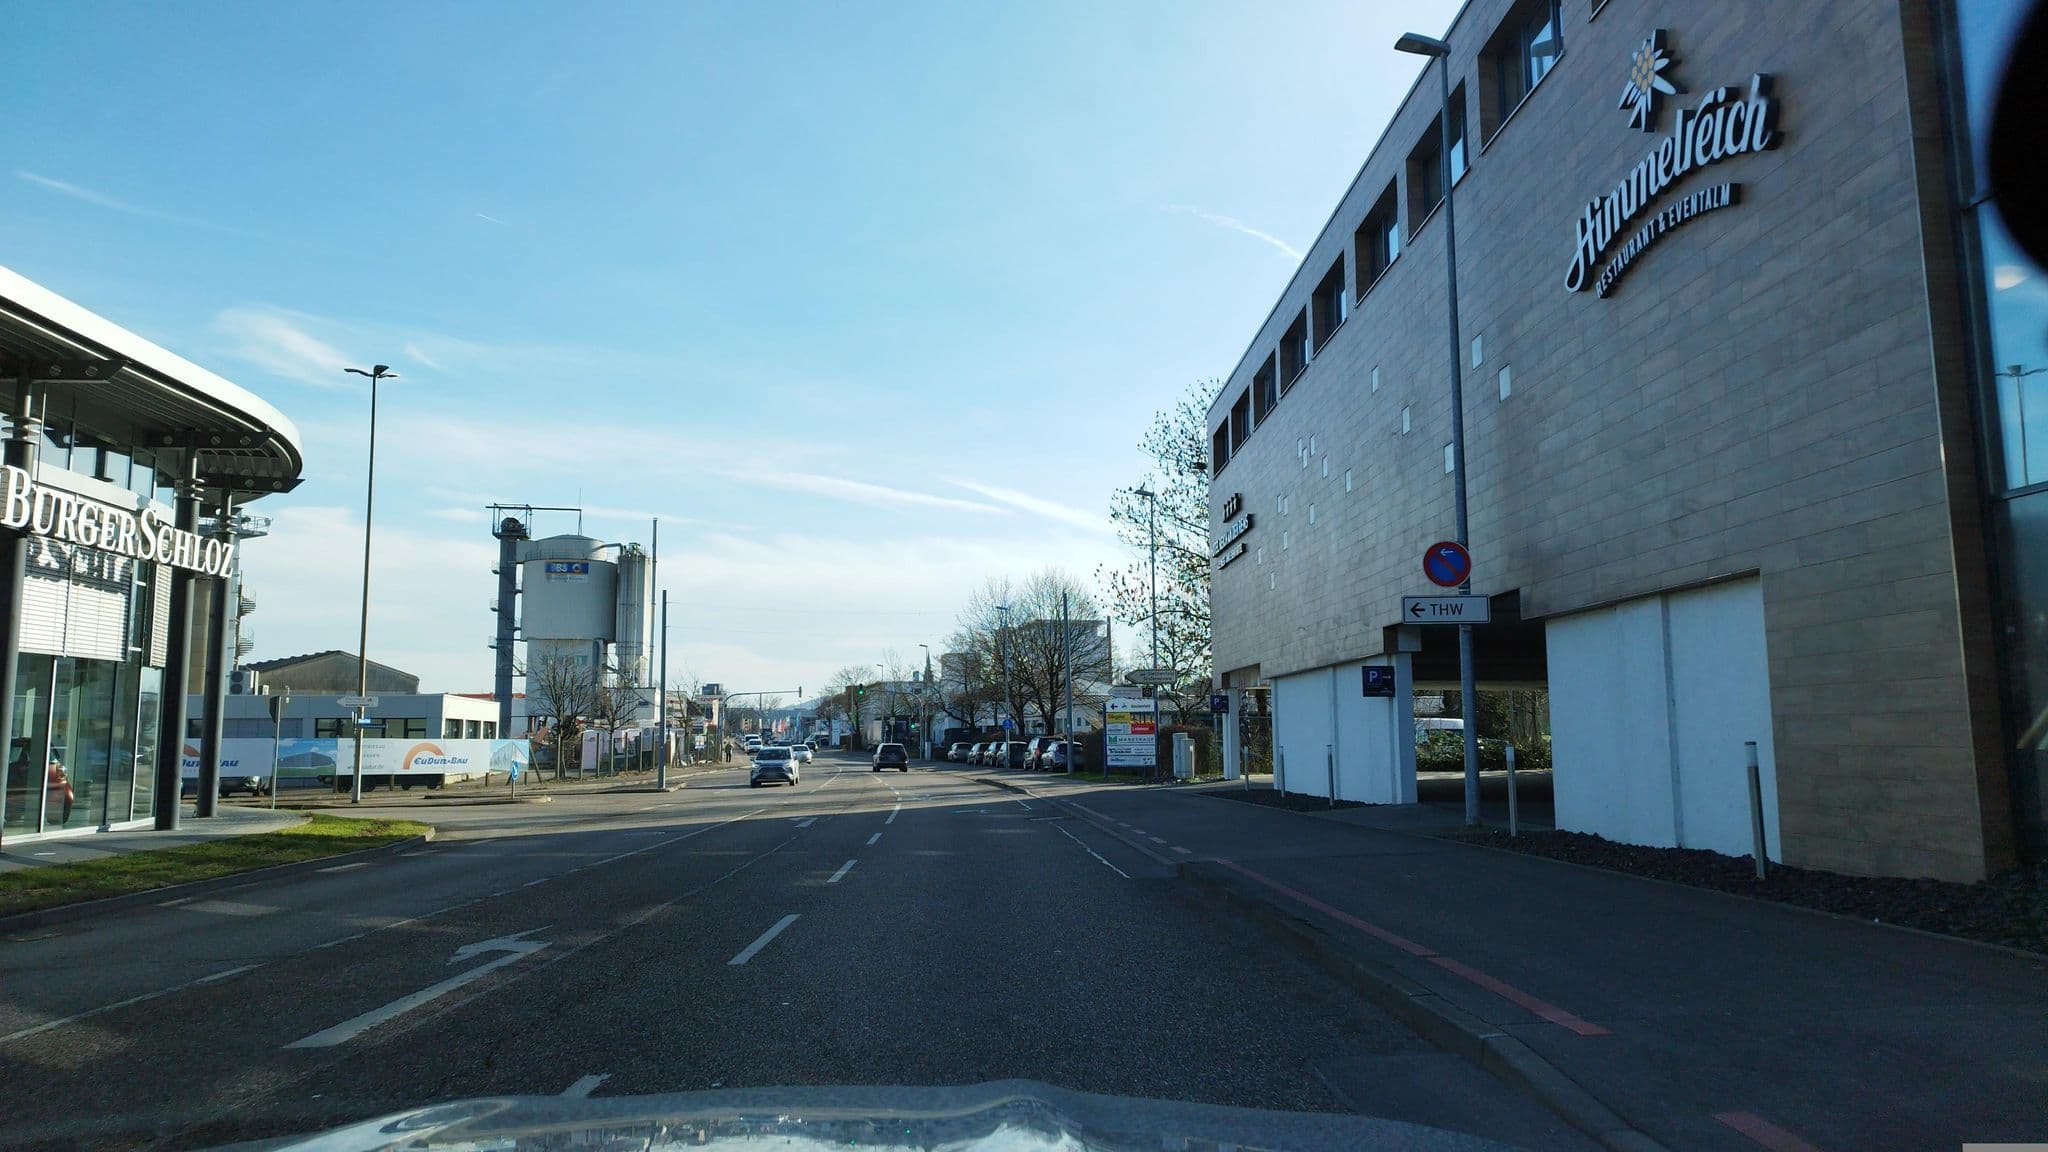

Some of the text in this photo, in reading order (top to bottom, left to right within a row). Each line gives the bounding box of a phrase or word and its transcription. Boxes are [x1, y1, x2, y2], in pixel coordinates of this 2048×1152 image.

[1564, 73, 1774, 294] Himmelreich
[1594, 182, 1733, 298] RESTAURANT & EVENTALM
[1429, 603, 1464, 616] THW
[1369, 670, 1378, 682] P
